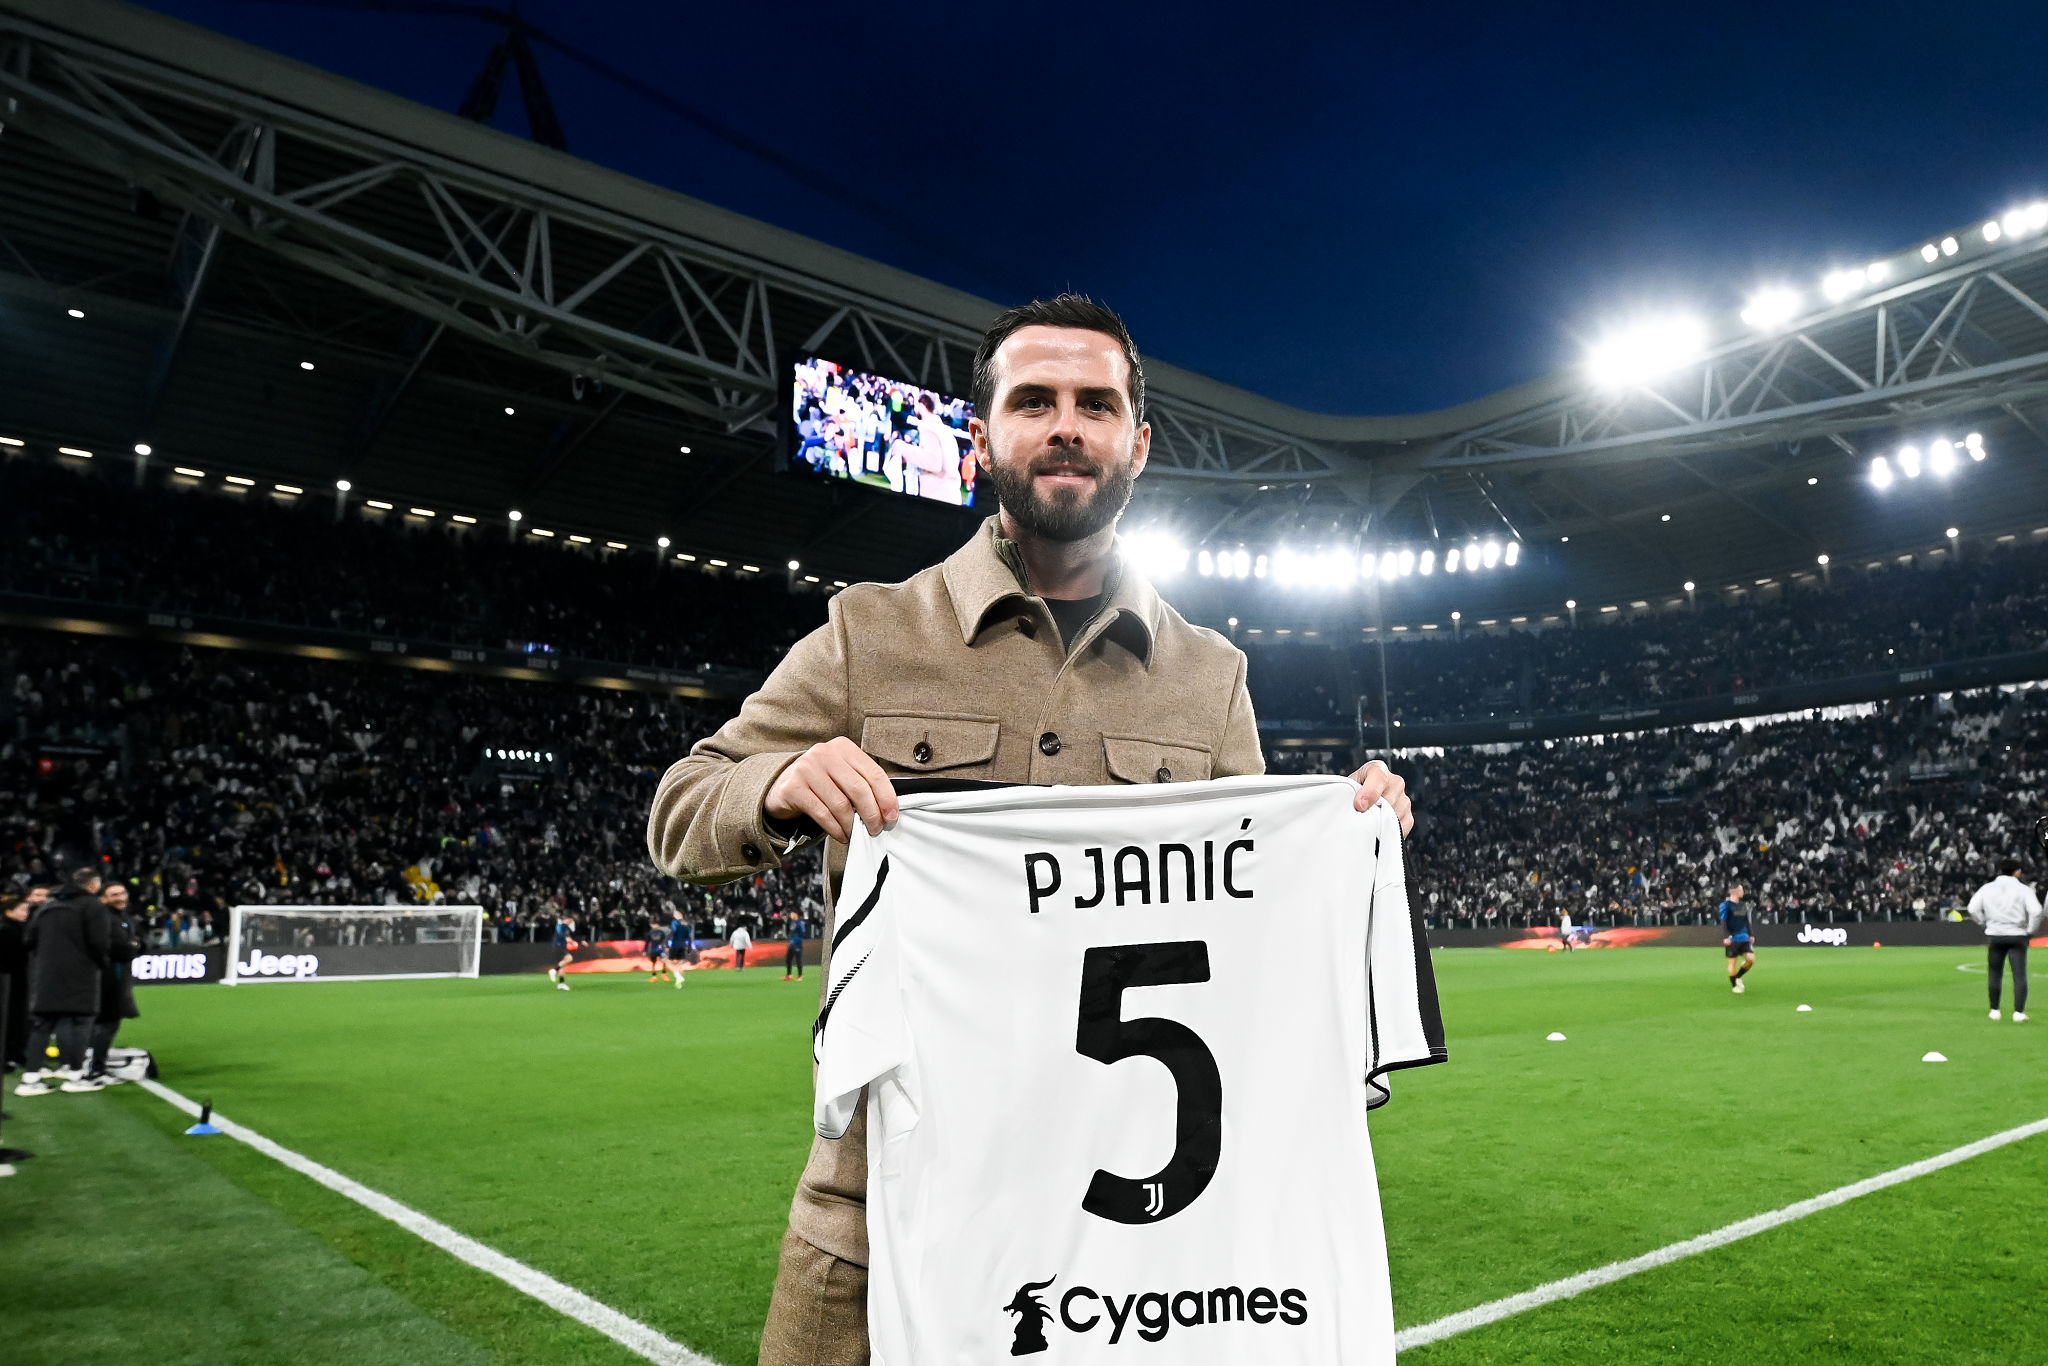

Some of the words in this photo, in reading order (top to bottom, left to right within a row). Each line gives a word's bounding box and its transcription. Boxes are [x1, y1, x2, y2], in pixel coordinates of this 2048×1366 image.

[1024, 818, 1254, 914] PJANIĆ
[237, 949, 319, 979] Jeep
[1797, 923, 1848, 946] Jeep
[1075, 940, 1223, 1225] 5
[1059, 1285, 1308, 1345] Cygames
